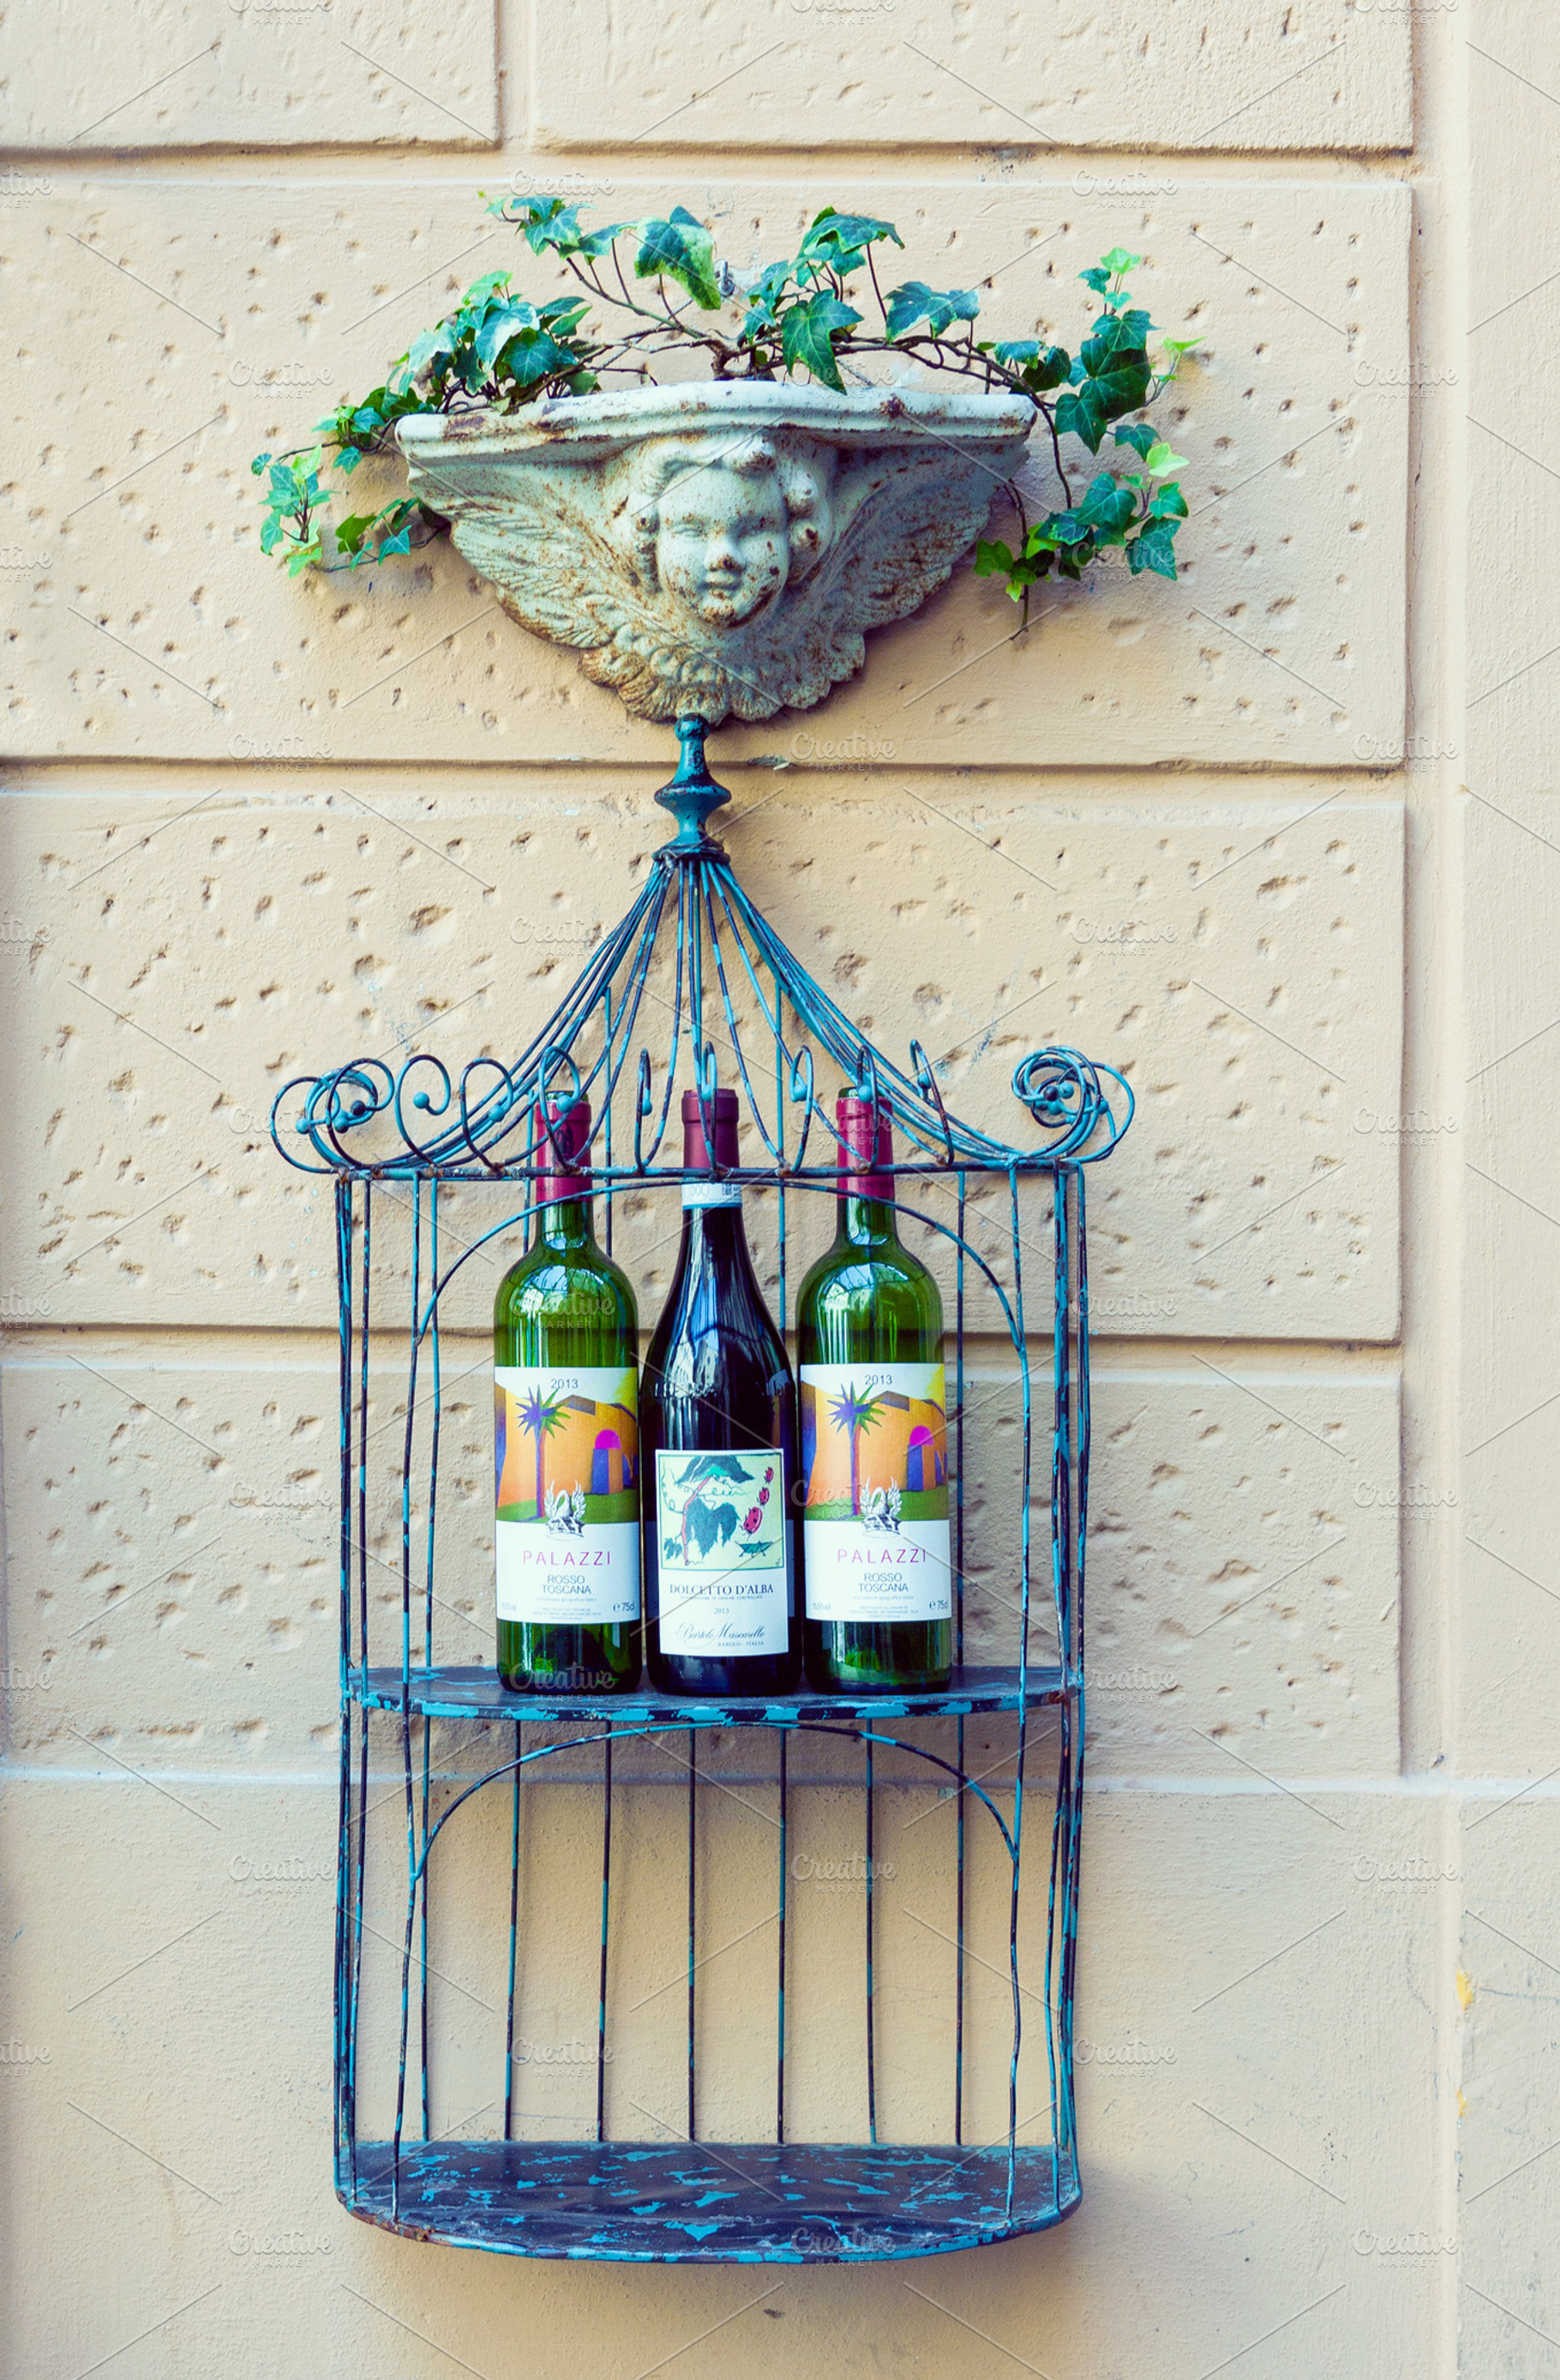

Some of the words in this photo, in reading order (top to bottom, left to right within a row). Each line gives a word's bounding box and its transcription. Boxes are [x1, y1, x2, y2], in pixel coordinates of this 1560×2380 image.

[550, 1378, 579, 1389] 2013
[865, 1374, 893, 1385] 2013
[523, 1550, 611, 1566] PALAZZI
[837, 1548, 927, 1564] PALAZZI
[547, 1574, 585, 1584] ROSSO
[863, 1572, 903, 1583] ROSSO
[542, 1584, 591, 1595] TOSCANA
[669, 1584, 732, 1596] DOLCETTO
[735, 1584, 774, 1596] D'ALBA
[858, 1583, 909, 1593] TOSCANA
